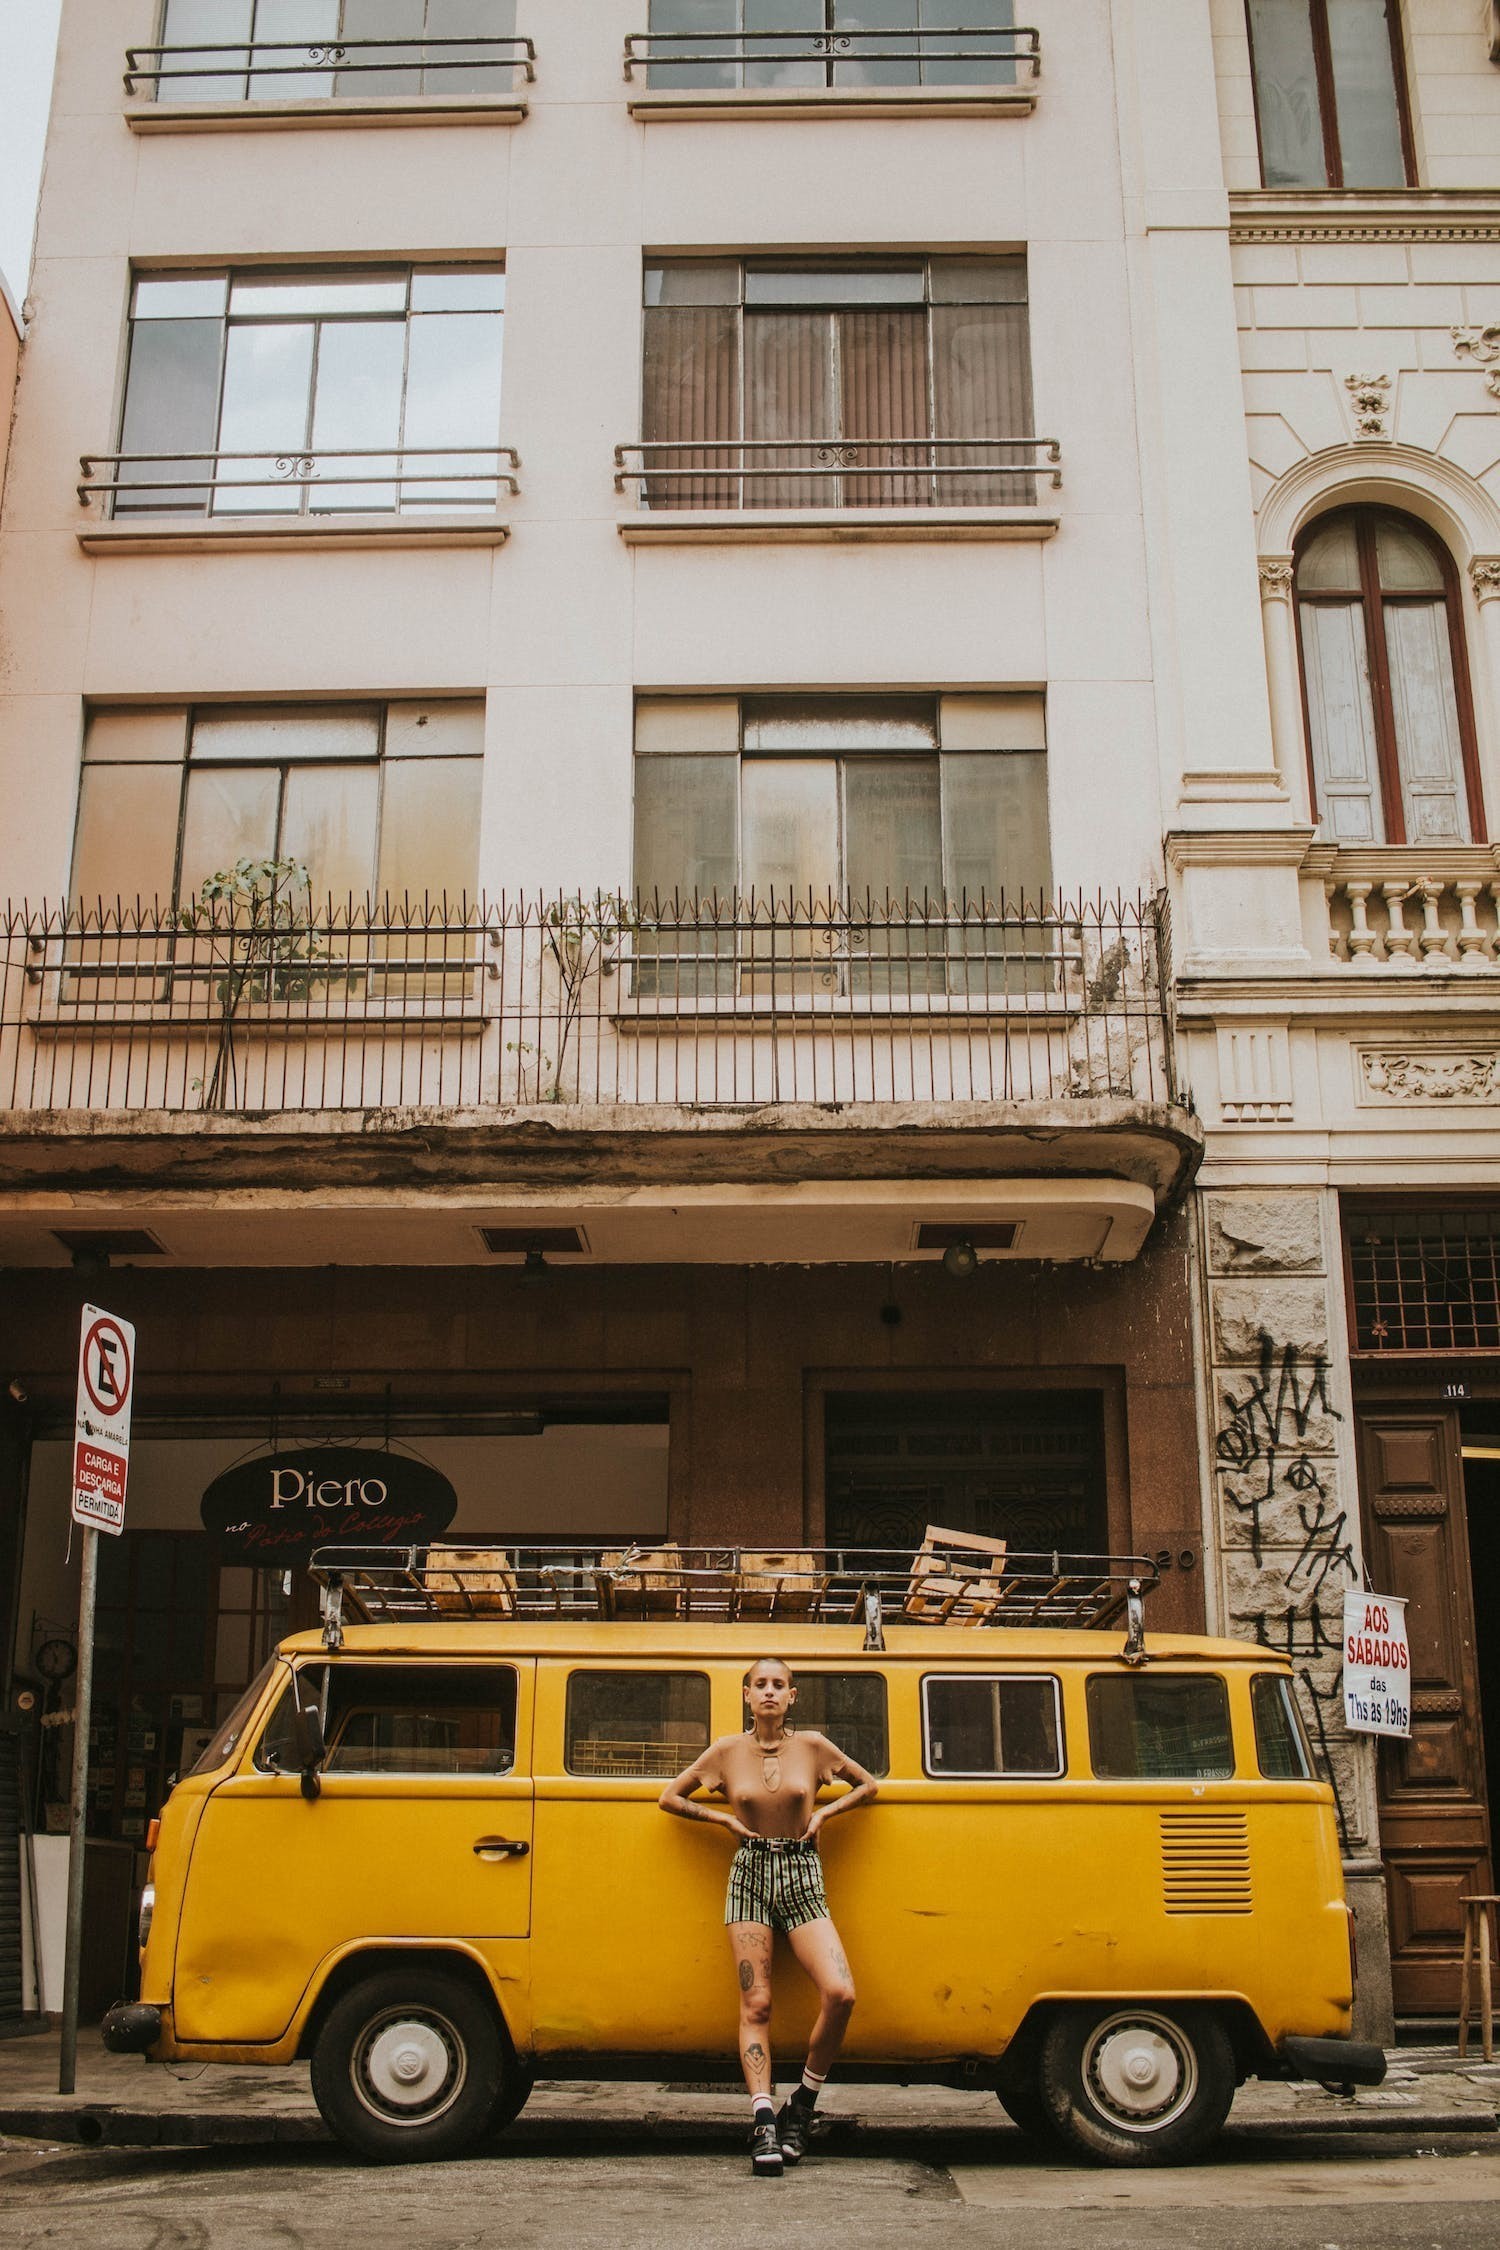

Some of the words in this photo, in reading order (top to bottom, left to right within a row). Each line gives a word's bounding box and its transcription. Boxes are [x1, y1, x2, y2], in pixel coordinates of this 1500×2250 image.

[1447, 1384, 1465, 1397] 114
[104, 1429, 128, 1446] AMARELA
[84, 1452, 112, 1473] CARGA
[113, 1462, 119, 1476] E
[79, 1469, 121, 1497] DESCARGA
[270, 1468, 388, 1509] Piero
[78, 1494, 119, 1519] PERMITIDA
[225, 1521, 252, 1533] no
[313, 1514, 336, 1538] do
[1143, 1549, 1196, 1567] 20
[1364, 1604, 1389, 1634] AOS
[1347, 1629, 1408, 1670] SÁBADOS
[1370, 1676, 1387, 1693] das
[1348, 1693, 1368, 1721] 7hs
[1371, 1696, 1382, 1724] às
[1385, 1697, 1408, 1727] 19hs
